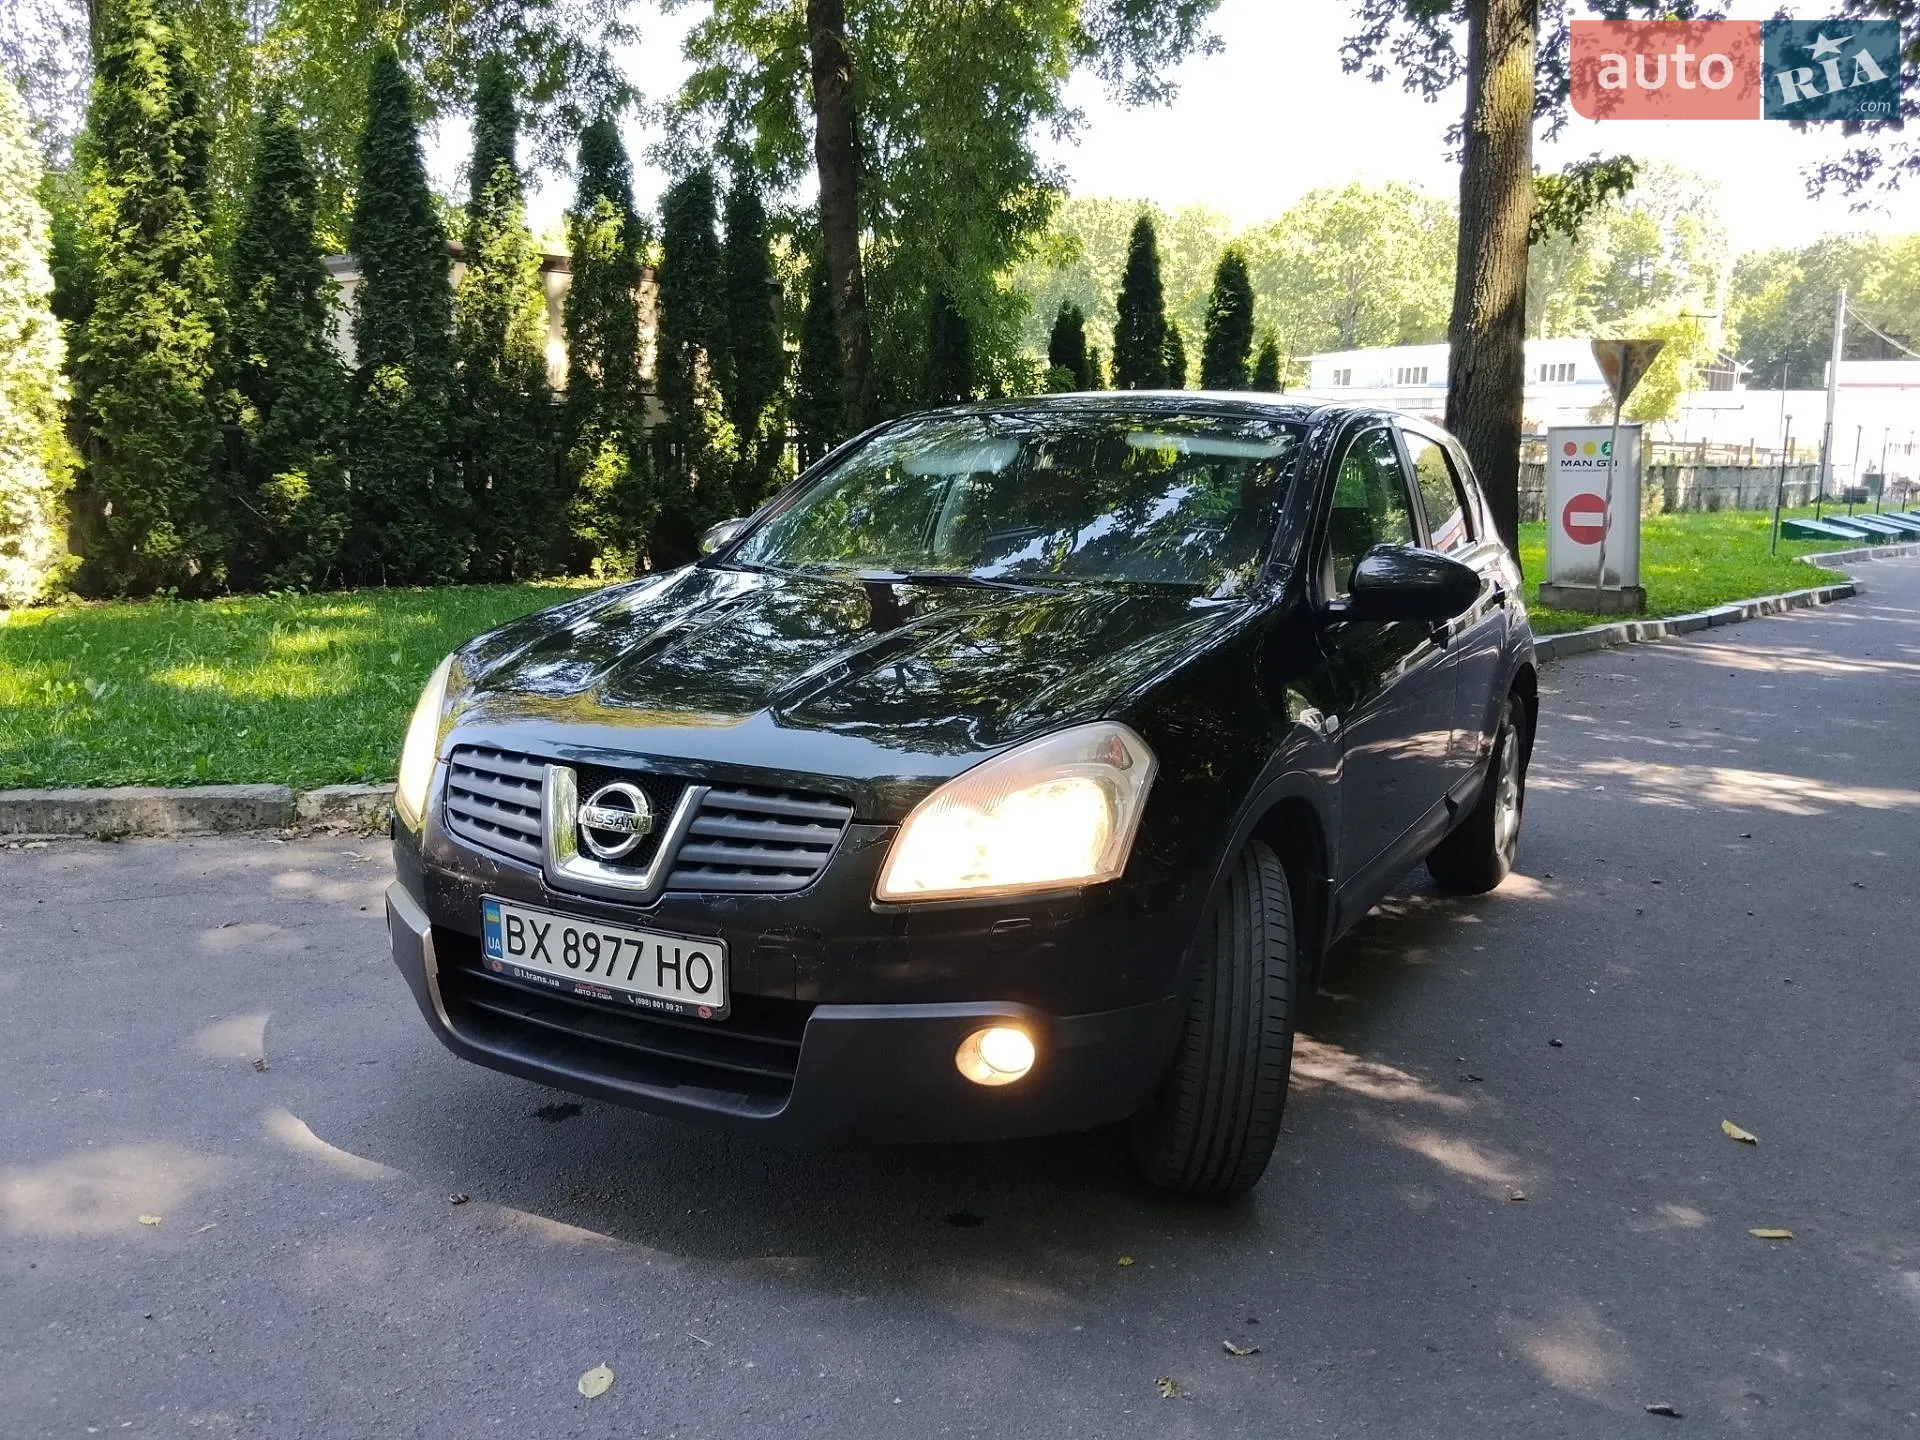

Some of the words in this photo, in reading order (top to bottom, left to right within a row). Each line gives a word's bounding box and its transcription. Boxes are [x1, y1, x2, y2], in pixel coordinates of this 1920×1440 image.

[583, 808, 640, 830] NISSAN
[487, 938, 502, 952] UA
[505, 913, 553, 964] BX
[562, 927, 644, 981] 8977
[656, 944, 714, 994] HO
